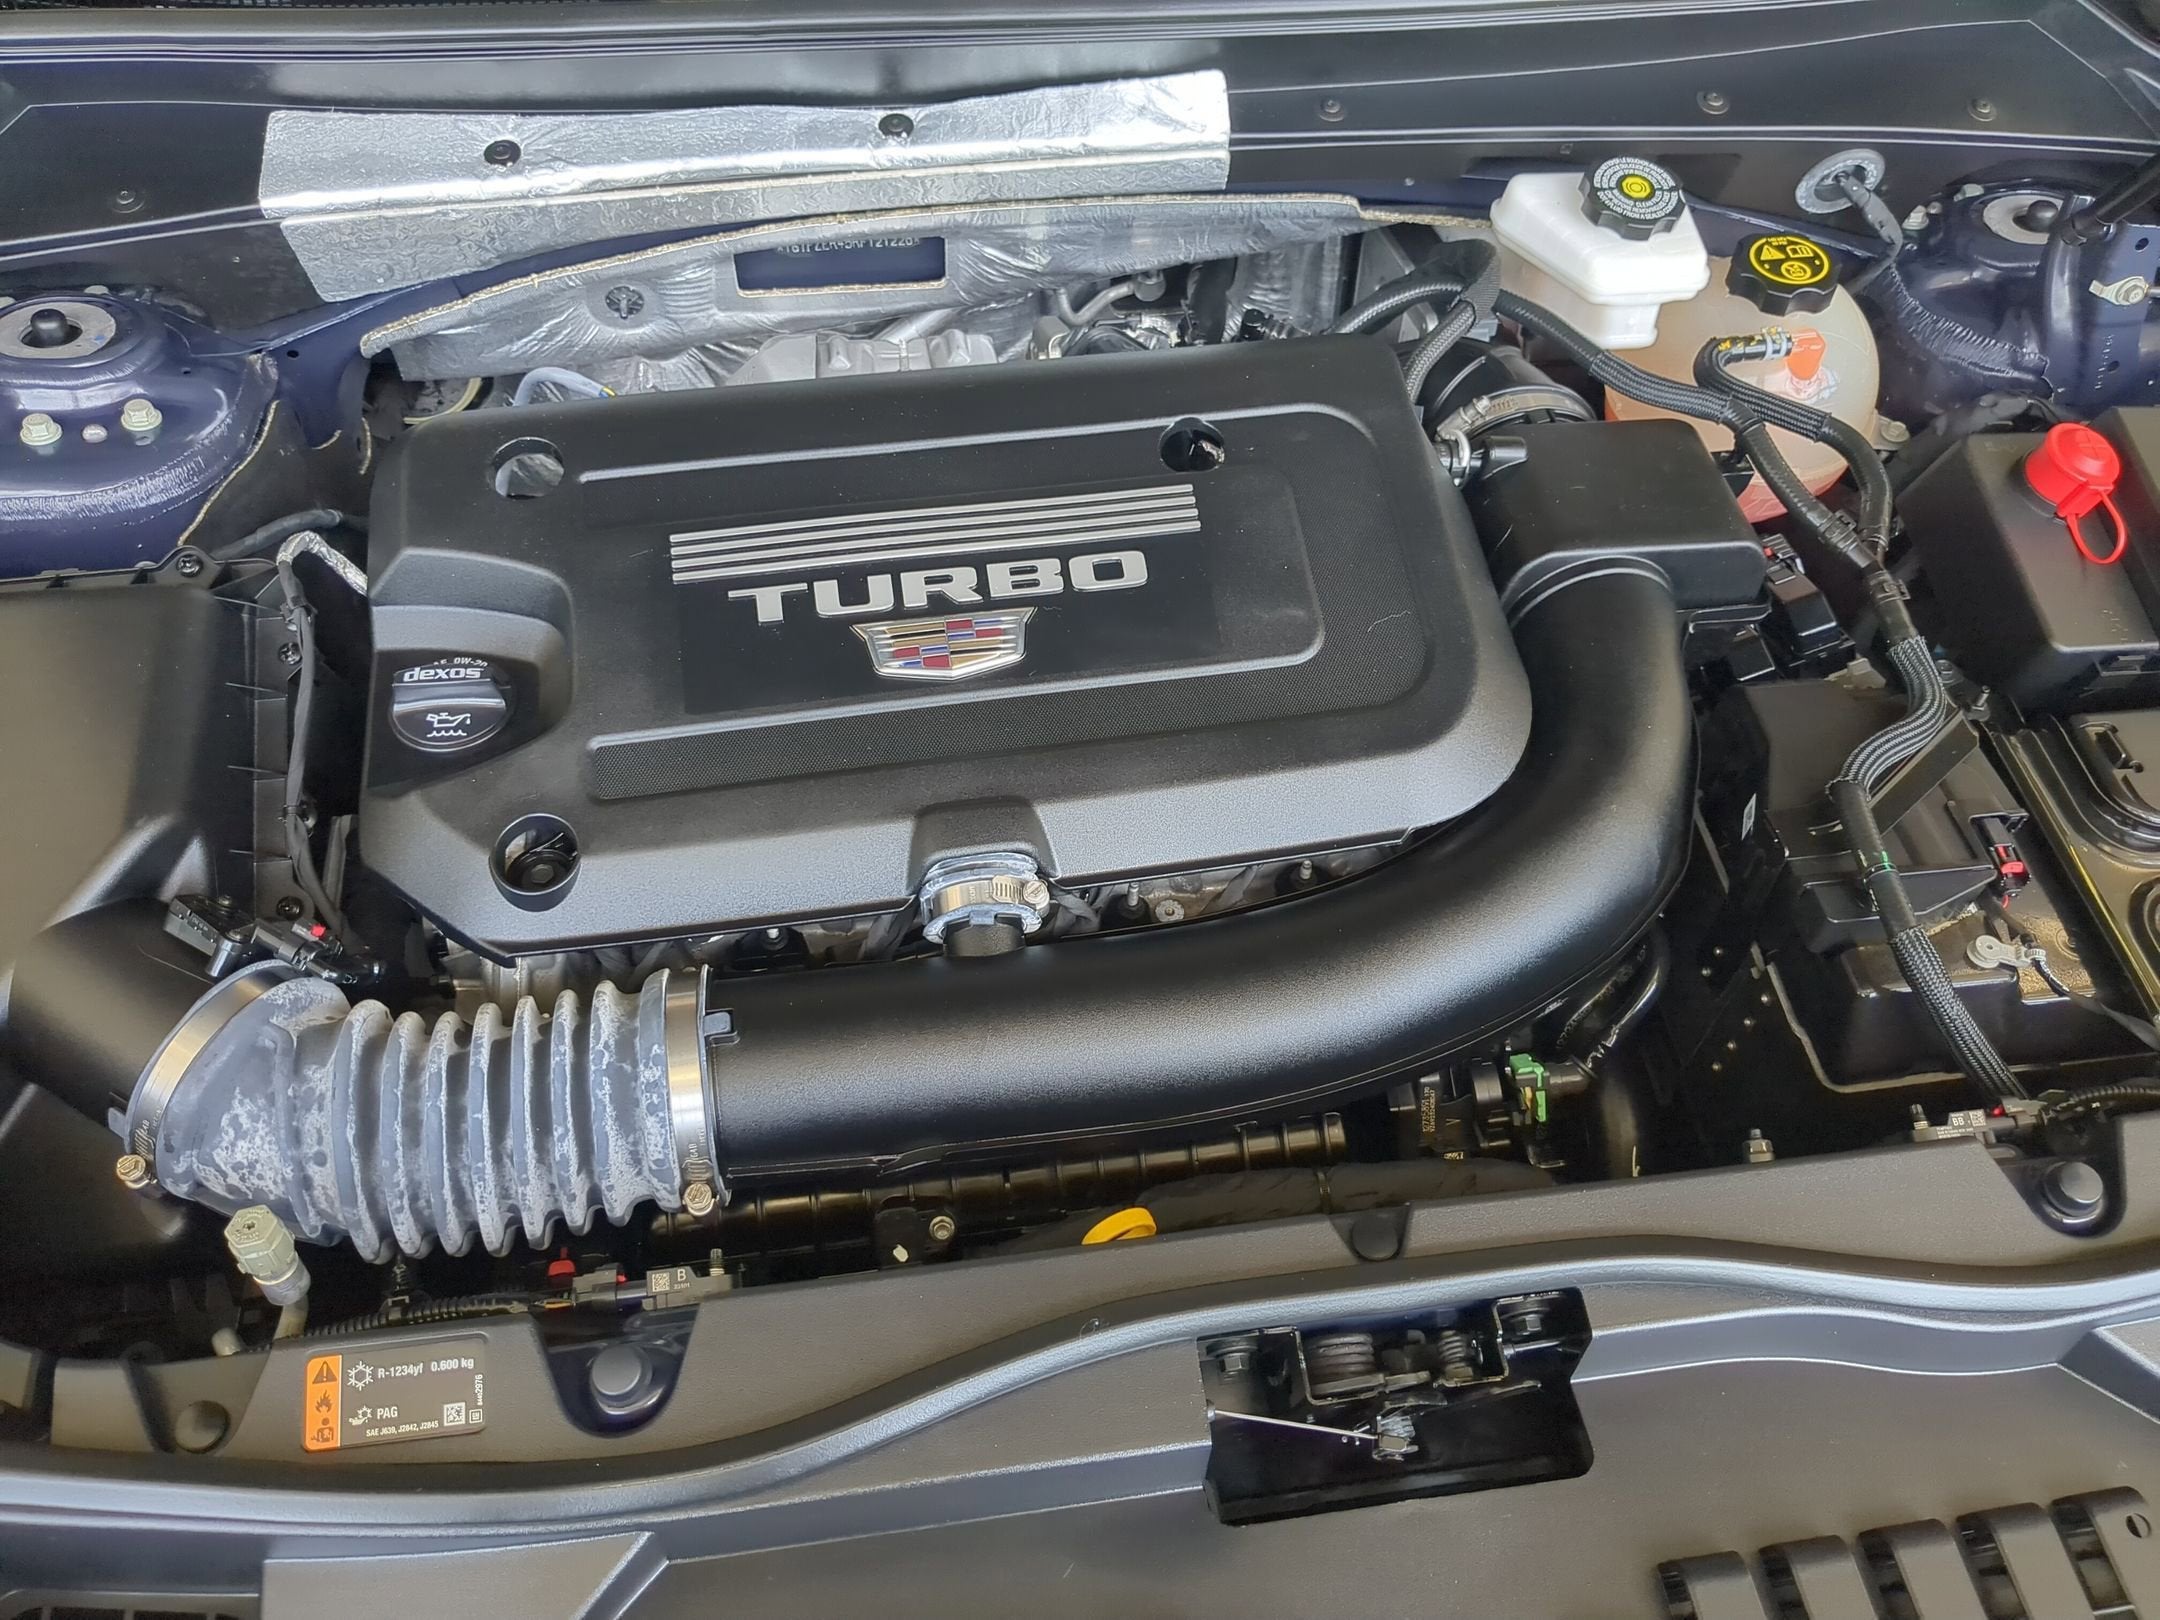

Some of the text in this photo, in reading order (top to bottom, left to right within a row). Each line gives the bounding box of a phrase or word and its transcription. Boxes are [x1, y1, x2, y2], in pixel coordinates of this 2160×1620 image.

[728, 550, 1149, 624] TURBO
[403, 667, 485, 682] dexos
[677, 1268, 687, 1281] B
[378, 1357, 475, 1379] R-1234yf 0.600 kg
[377, 1406, 398, 1420] PAG
[366, 1427, 380, 1437] SAE
